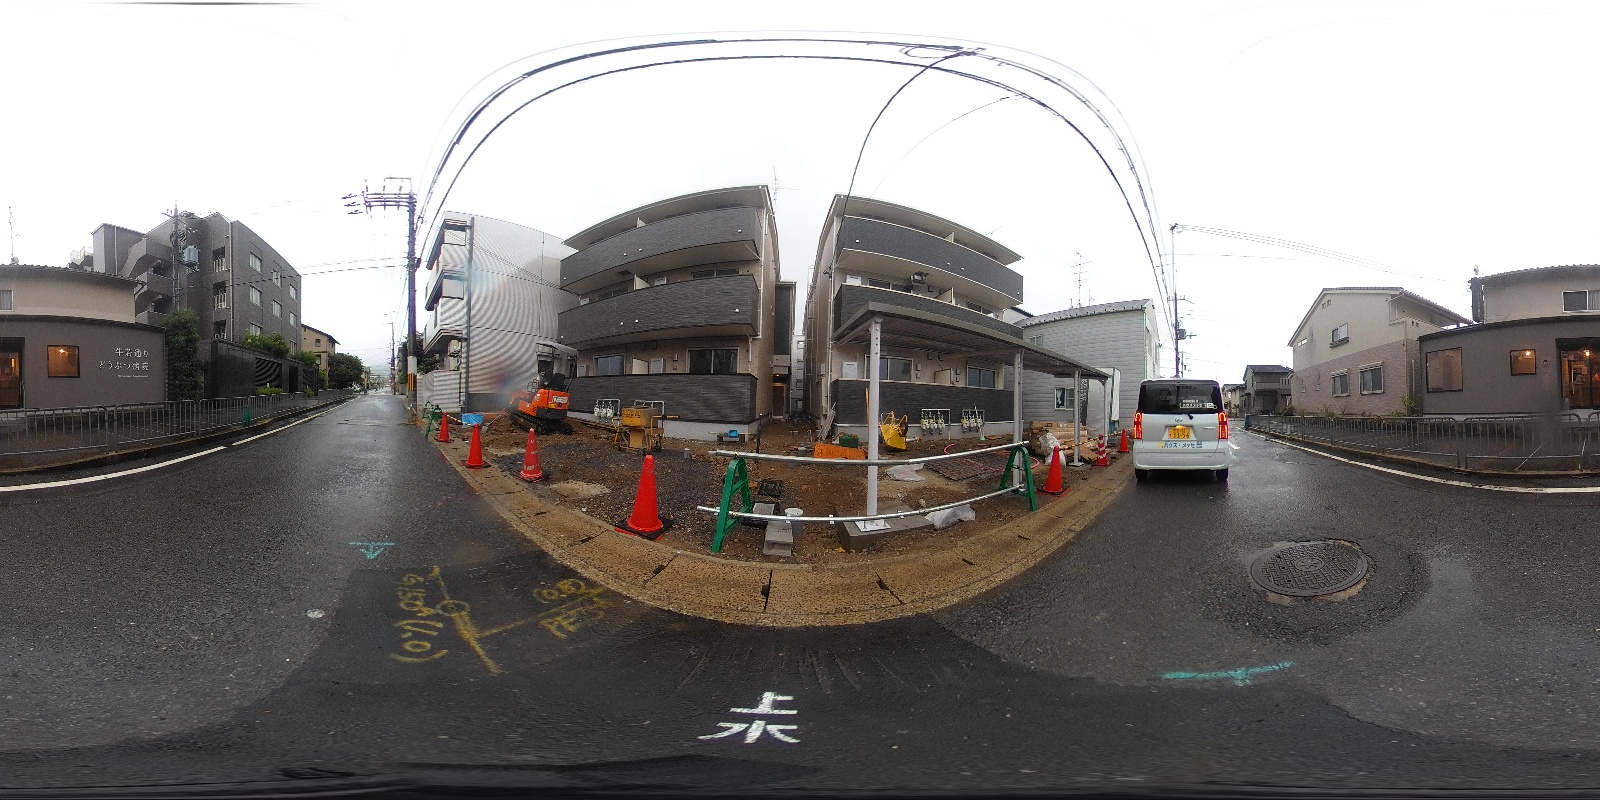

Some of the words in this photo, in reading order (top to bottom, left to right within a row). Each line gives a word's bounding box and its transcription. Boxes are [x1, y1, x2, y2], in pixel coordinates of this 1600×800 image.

[115, 347, 149, 358] 牛若通り
[99, 360, 149, 371] どうぶつ病院
